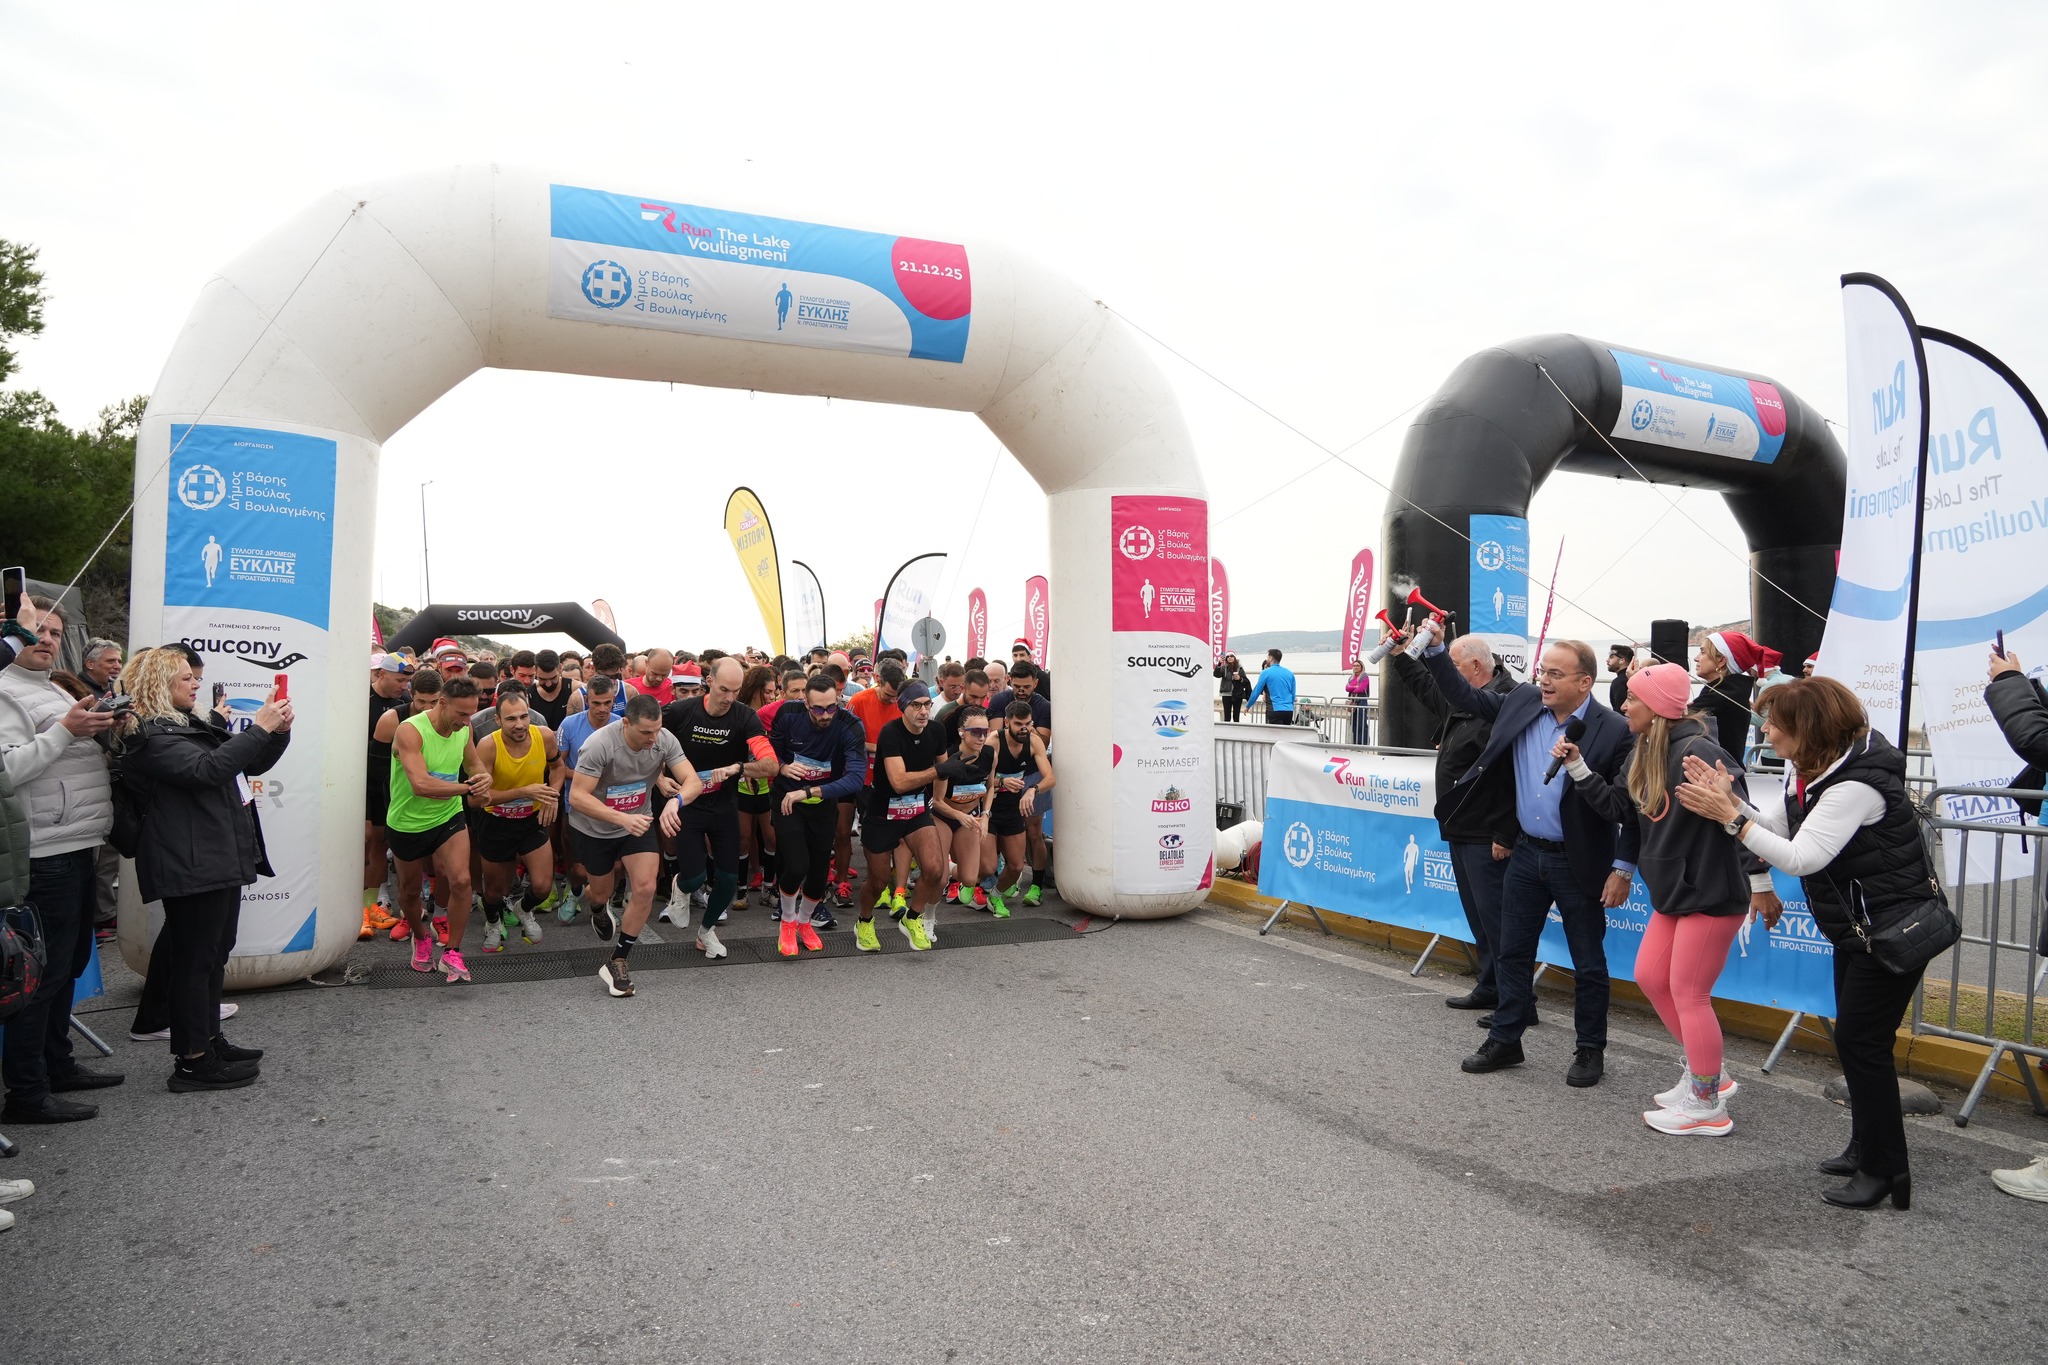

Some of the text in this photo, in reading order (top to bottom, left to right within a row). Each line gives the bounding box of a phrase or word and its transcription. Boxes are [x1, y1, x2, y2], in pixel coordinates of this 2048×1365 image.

[681, 222, 791, 249] Run The Lake
[687, 236, 787, 262] Vouliagmeni
[899, 261, 963, 280] 21.12.25
[652, 271, 690, 288] Βάρης
[634, 270, 649, 311] Δήμος
[651, 287, 693, 304] Βούλας
[650, 302, 728, 323] Βουλιαγμένης
[798, 305, 849, 322] ΕΥΚΛΗΣ
[233, 441, 274, 450] ΔΙΟΡΓΑΝΩΣΗ
[246, 471, 287, 487] Βάρης
[228, 471, 244, 511] Δήμος
[246, 486, 291, 502] Βούλας
[245, 501, 326, 521] Βουλιαγμένης
[1167, 529, 1189, 539] Βάρης
[231, 547, 296, 558] ΣΥΛΛΟΓΟΣ ΔΡΟΜΕΩΝ
[1167, 541, 1191, 551] Βούλας
[230, 558, 296, 575] ΕΥΚΛΗΣ
[237, 575, 271, 583] ΠΡΟΑΣΤΙΩΝ
[271, 576, 295, 585] ΑΤΤΙΚΗΣ
[1160, 595, 1195, 605] ΕΥΚΛΗΣ
[457, 608, 533, 622] saucony
[1127, 656, 1191, 670] saucony
[693, 725, 730, 737] saucony
[1137, 757, 1200, 768] PHARMASEPT
[1346, 772, 1421, 792] Run The Lake
[614, 795, 639, 806] 1440
[1350, 787, 1418, 807] Vouliagmeni
[1153, 800, 1189, 812] MISKO
[1325, 830, 1350, 846] Βάρης
[1314, 830, 1324, 869] Δήμος
[1324, 845, 1353, 862] Βούλας
[1323, 861, 1376, 882] Βουλιαγμένης
[1424, 861, 1456, 881] ΕΥΚΛ
[241, 892, 290, 901] AGNOSIS
[1779, 942, 1822, 954] ΠΡΟΑΣΤΙΩΝ
